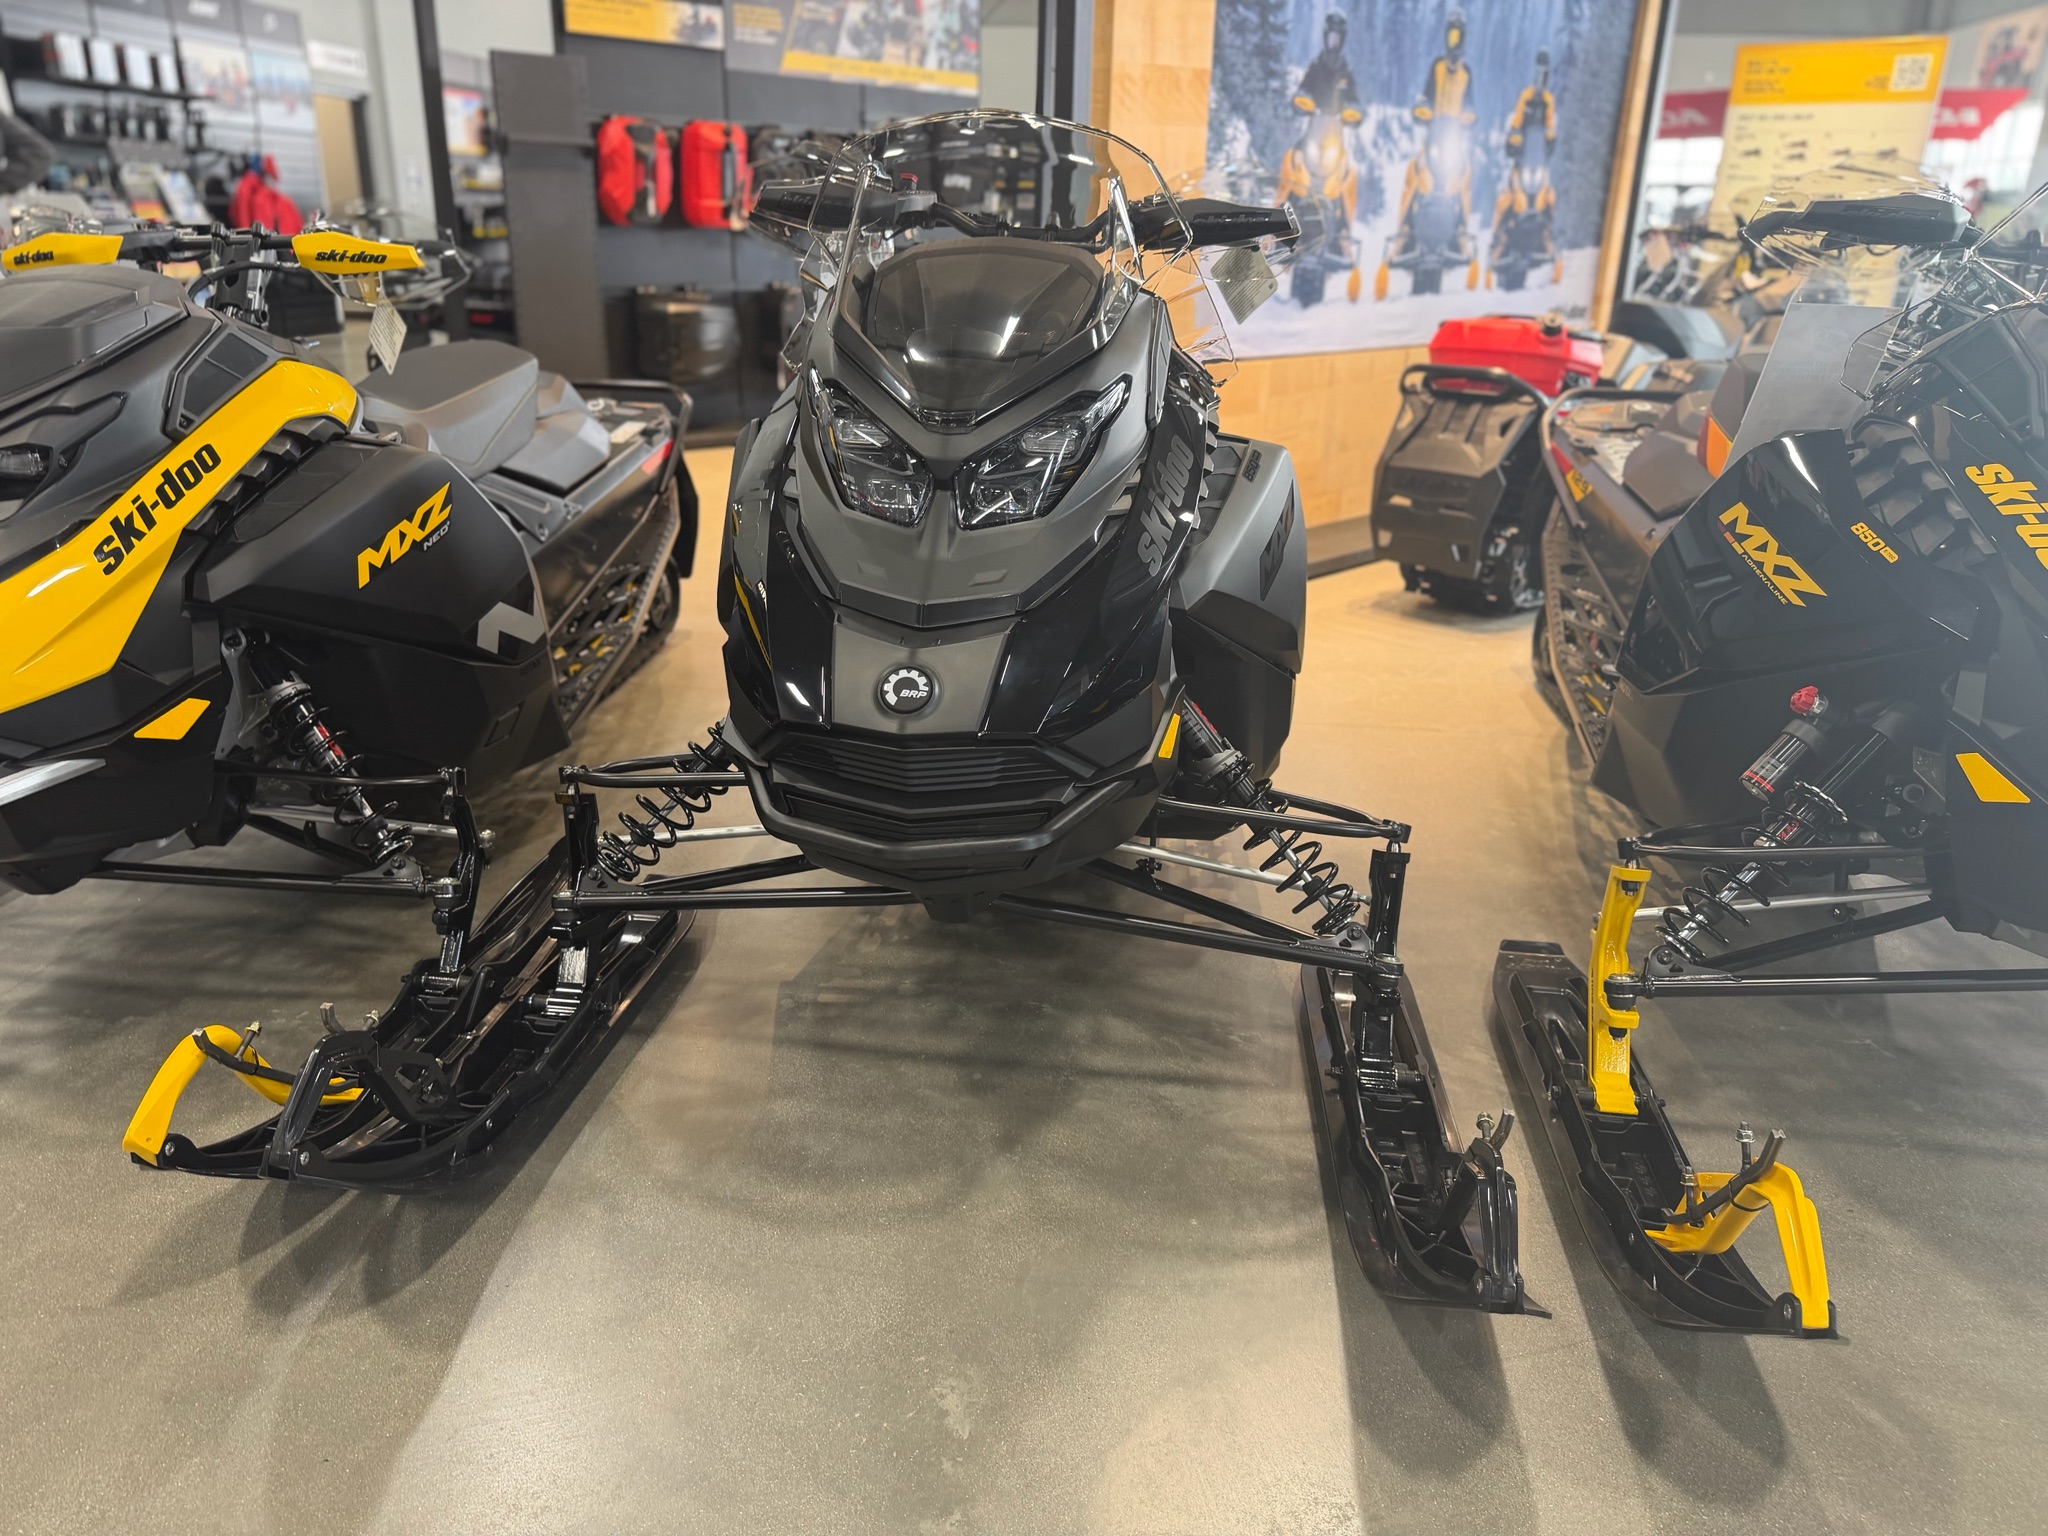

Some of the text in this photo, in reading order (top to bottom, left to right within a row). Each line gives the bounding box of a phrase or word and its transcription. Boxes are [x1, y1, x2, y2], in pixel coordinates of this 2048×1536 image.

[13, 249, 54, 266] ski-doo
[313, 250, 388, 264] ski-doo
[92, 443, 222, 576] ski-doo
[1138, 434, 1194, 577] ski-doo
[356, 481, 453, 590] MXZ
[1718, 501, 1828, 607] MXZ
[1850, 522, 1886, 552] 850
[1741, 553, 1788, 606] ADRENALINE
[900, 689, 928, 699] BRP
